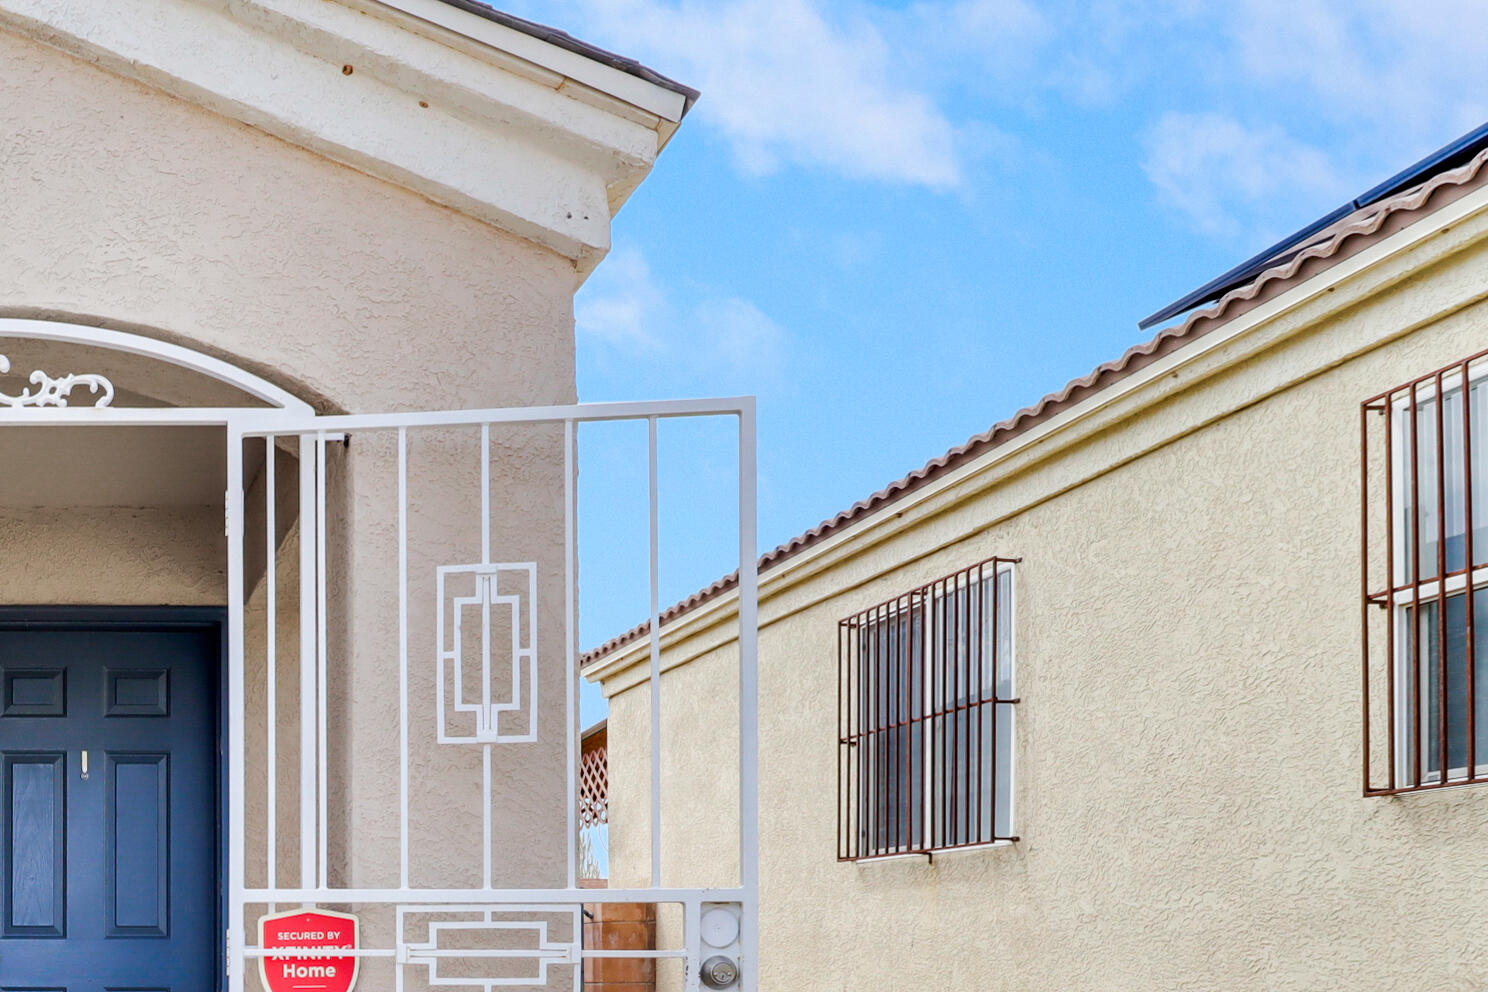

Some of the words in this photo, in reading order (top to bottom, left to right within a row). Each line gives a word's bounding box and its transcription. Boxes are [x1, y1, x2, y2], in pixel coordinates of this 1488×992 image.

[277, 931, 324, 940] SECURED
[327, 931, 341, 939] BY
[283, 963, 337, 978] Home
